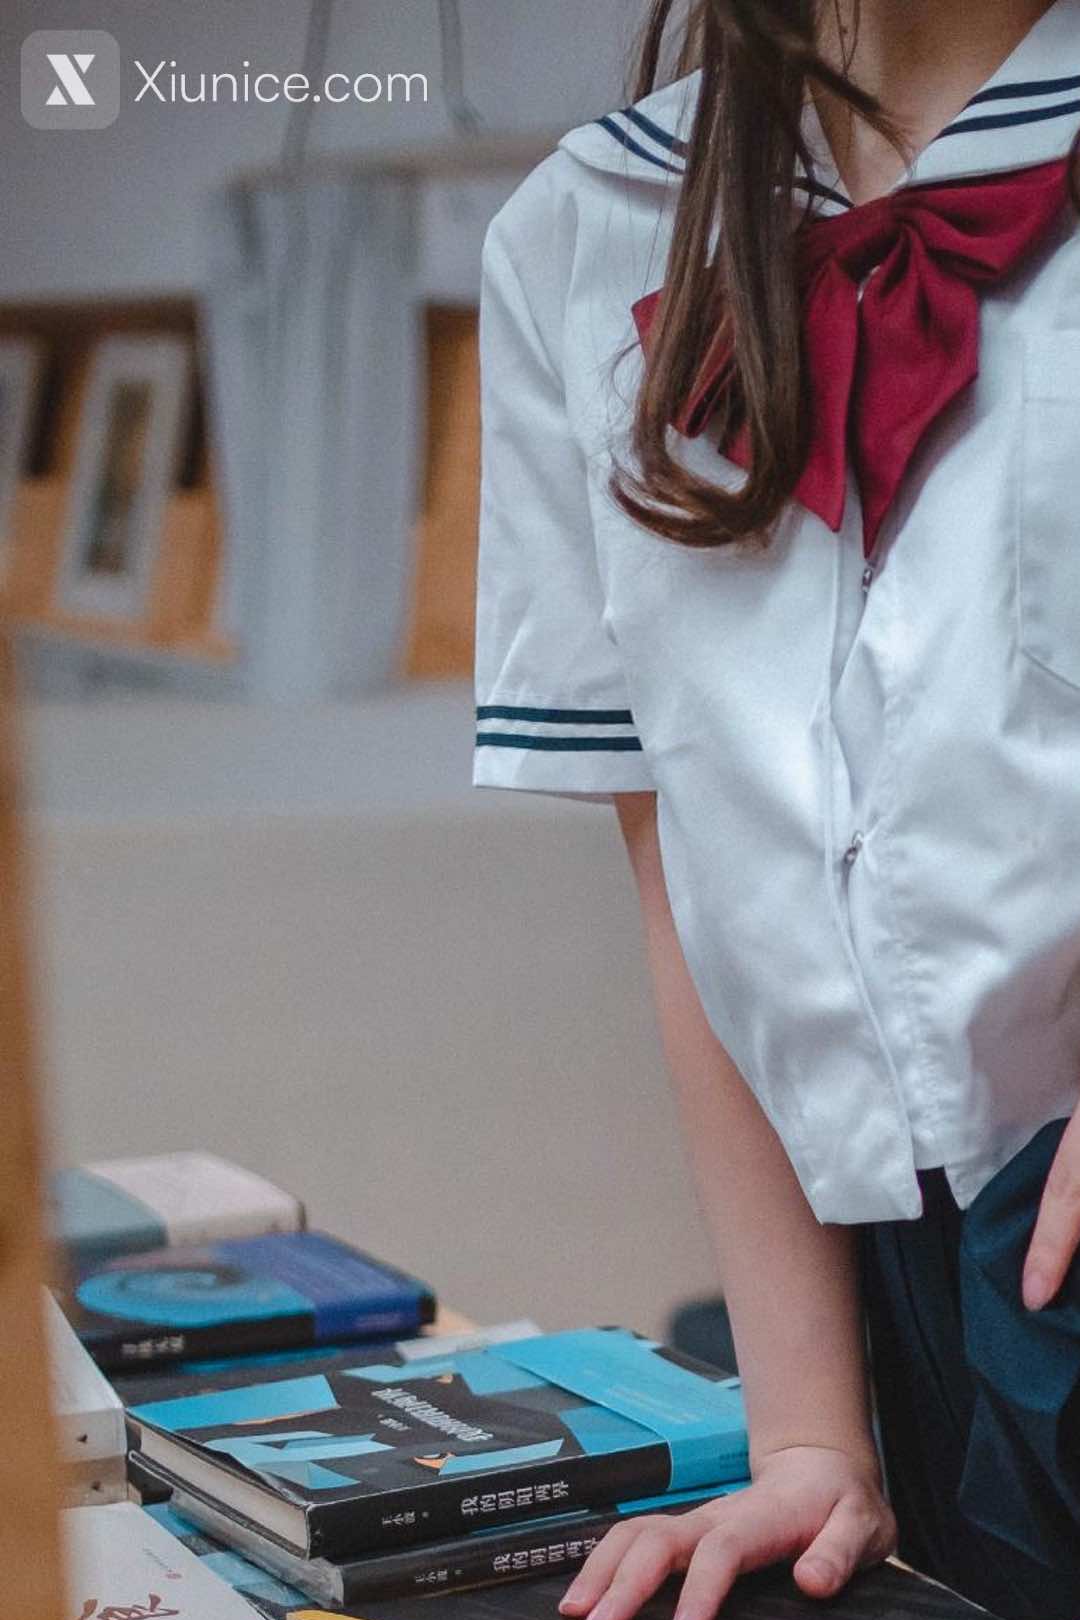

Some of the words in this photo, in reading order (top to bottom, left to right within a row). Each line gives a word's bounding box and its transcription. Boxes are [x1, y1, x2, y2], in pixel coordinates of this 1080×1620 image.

[460, 1480, 570, 1517] 我的阴阳两界
